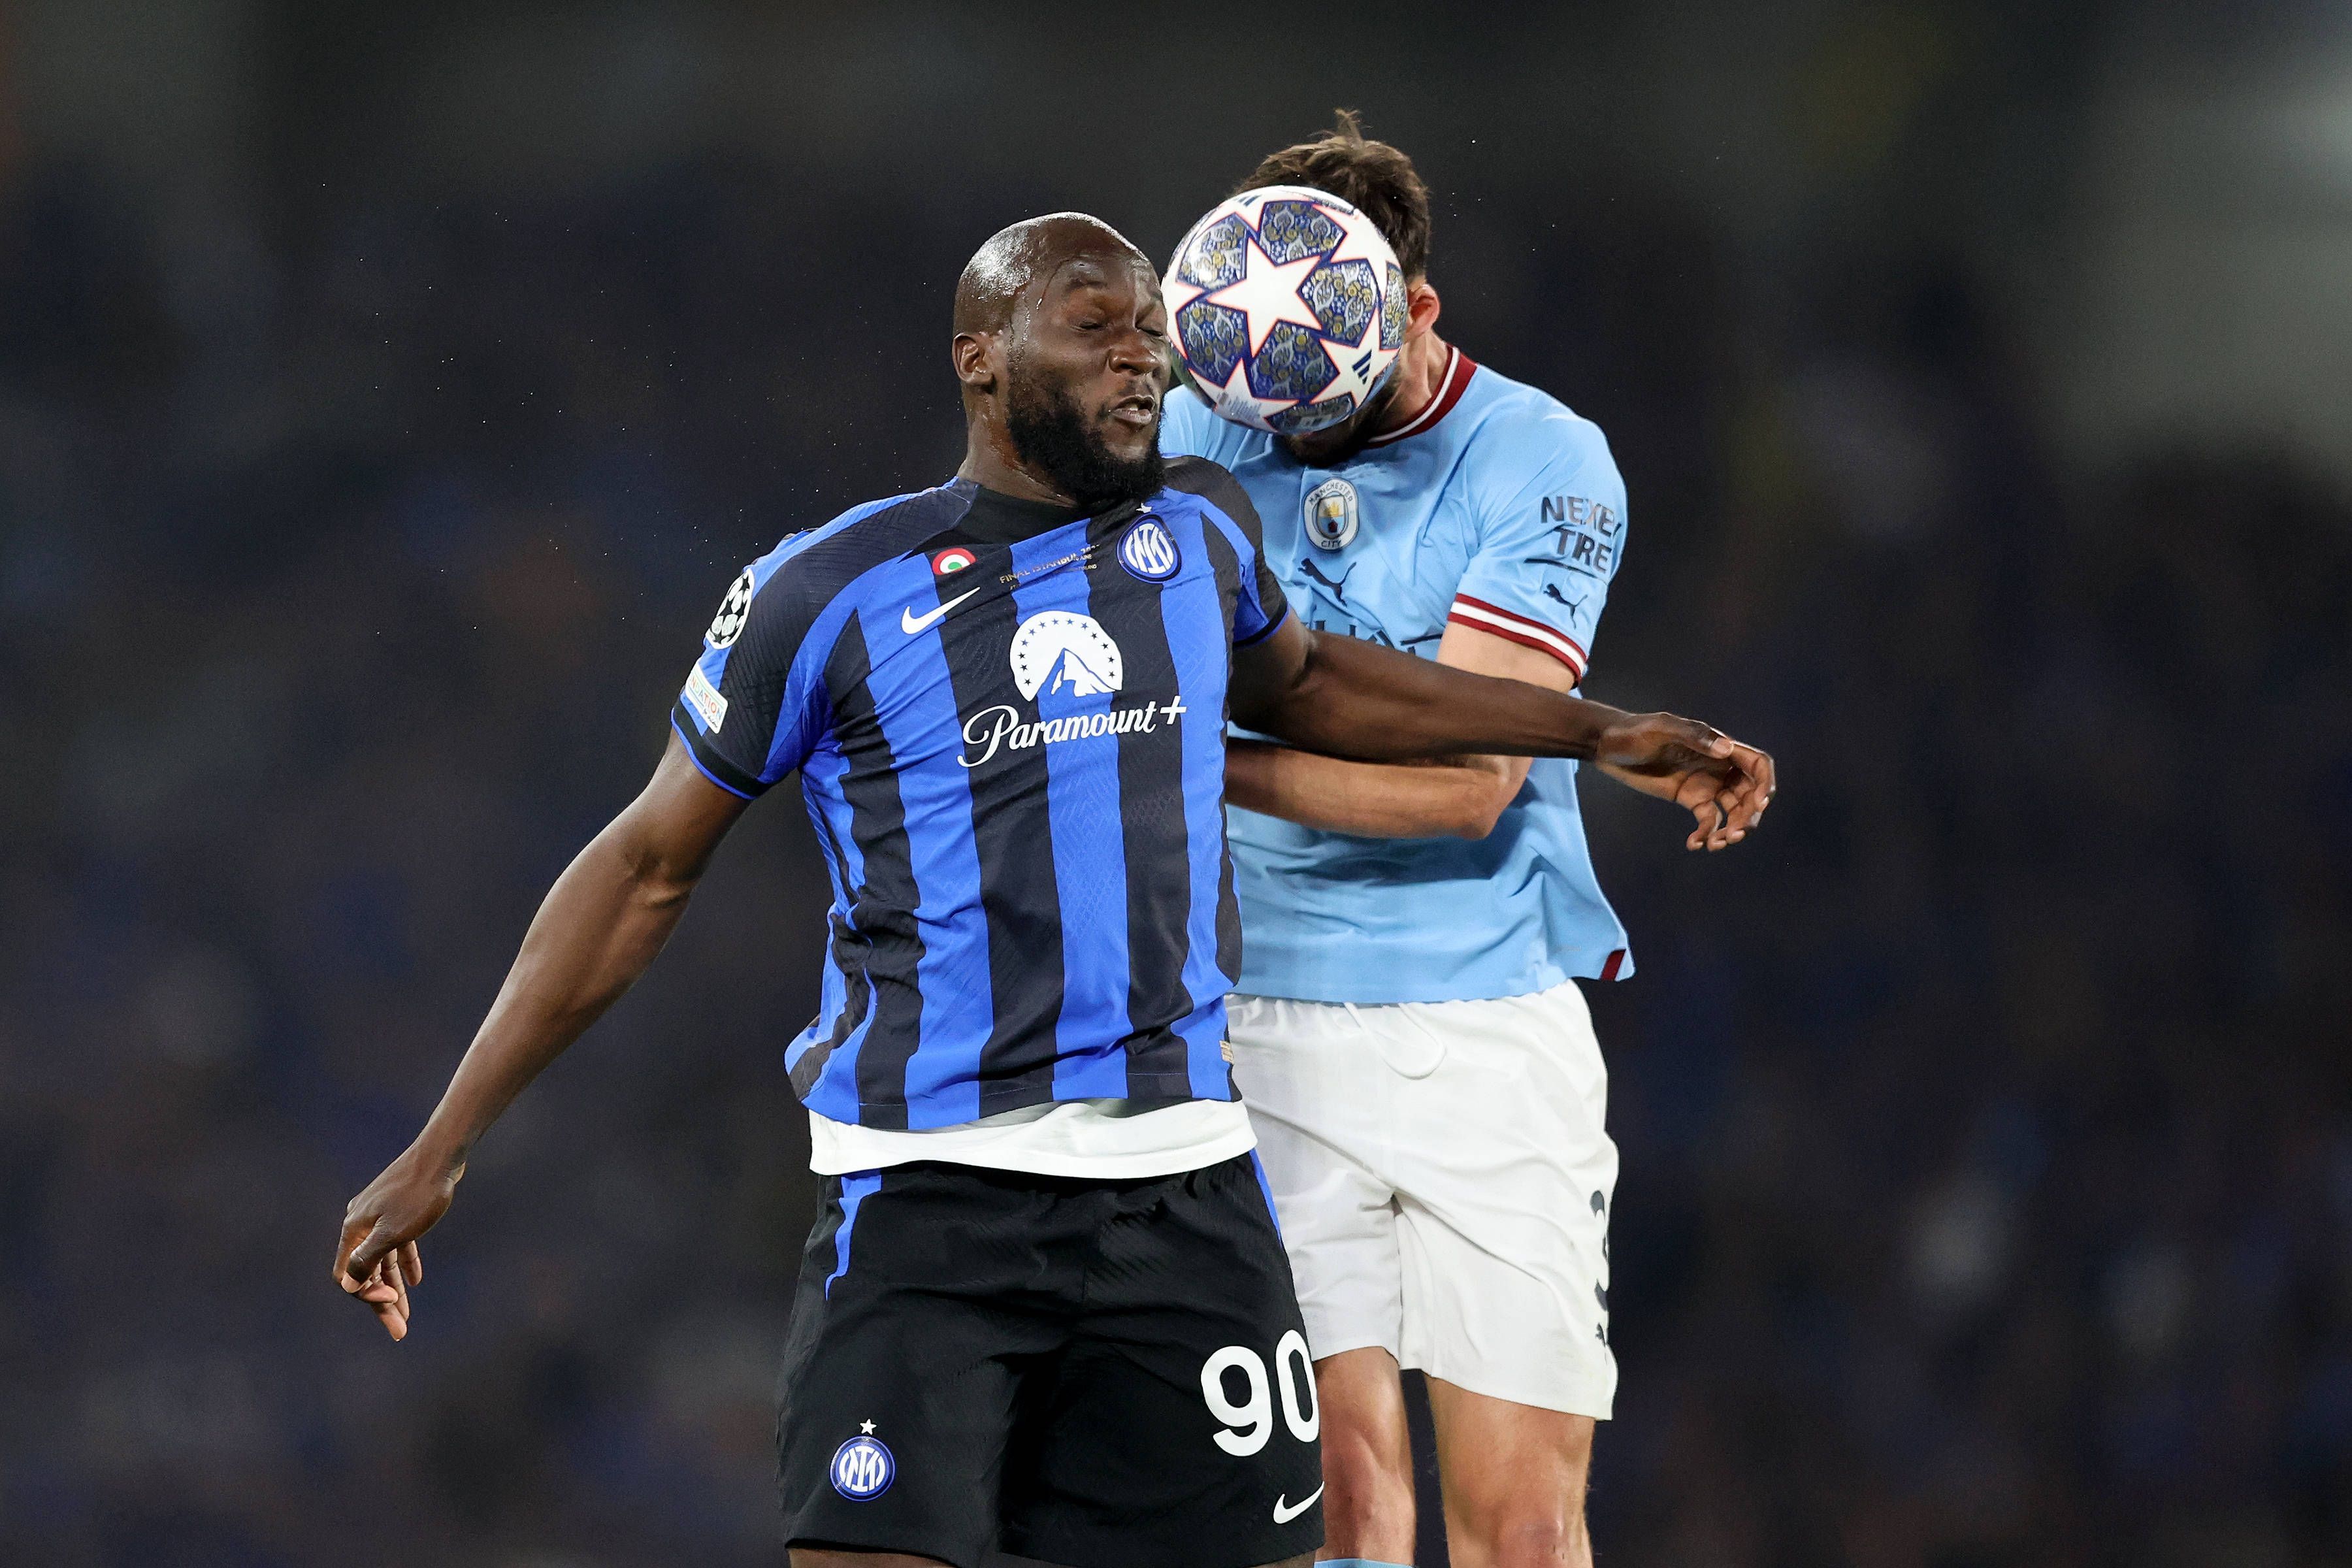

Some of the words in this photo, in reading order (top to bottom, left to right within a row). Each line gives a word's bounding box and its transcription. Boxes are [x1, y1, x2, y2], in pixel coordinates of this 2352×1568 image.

[1309, 482, 1353, 505] MANCHESTER
[1541, 496, 1622, 539] NEXE
[1321, 540, 1342, 548] CITY
[1000, 569, 1031, 584] FINAL
[691, 675, 723, 721] NDATION
[956, 695, 1187, 768] Paramount+
[1201, 1329, 1320, 1457] 90
